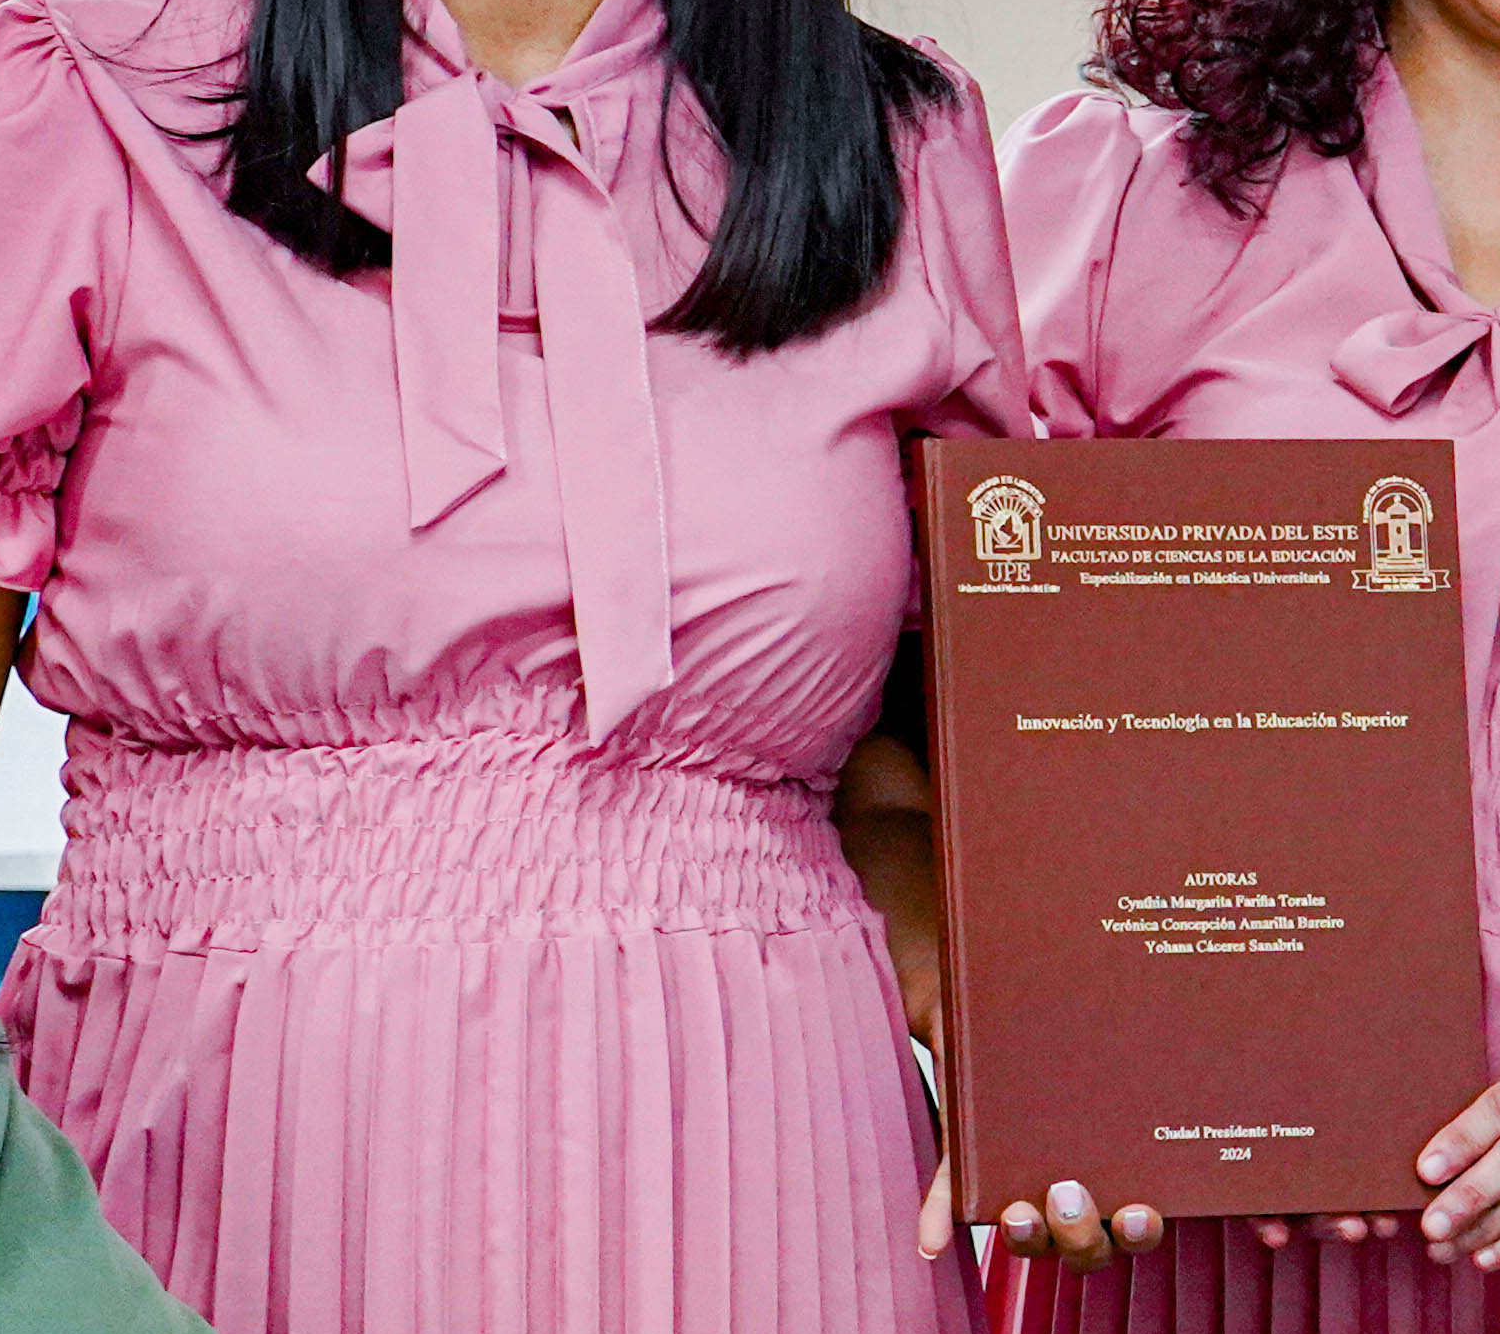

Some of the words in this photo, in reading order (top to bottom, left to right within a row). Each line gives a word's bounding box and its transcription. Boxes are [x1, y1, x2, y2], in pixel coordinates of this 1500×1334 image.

[1046, 524, 1178, 541] UNIVERSIDAD
[1182, 524, 1267, 541] PRIVADA
[1270, 524, 1310, 541] DEL
[1312, 524, 1359, 541] ESTE
[1050, 550, 1130, 564] FACULTAD
[1131, 550, 1153, 564] DE
[1154, 550, 1223, 564] CIENCIAS
[1225, 550, 1246, 564] DE
[1248, 550, 1269, 564] LA
[1270, 547, 1357, 563] EDUCACIÓN
[986, 561, 1032, 583] UPE
[1079, 571, 1174, 588] Especialización
[1175, 574, 1191, 585] en
[1192, 571, 1251, 585] Didáctica
[1252, 570, 1331, 585] Universitaria
[1016, 713, 1104, 731] Innovación
[1106, 717, 1119, 734] y
[1212, 716, 1233, 729] en
[1235, 712, 1253, 729] la
[1254, 711, 1338, 729] Educación
[1341, 710, 1409, 732] Superior
[1184, 871, 1258, 887] AUTORAS
[1117, 895, 1169, 913] Cynthia
[1170, 894, 1233, 912] Margarita
[1277, 893, 1326, 908] Torales
[1100, 917, 1160, 933] Verónica
[1161, 916, 1237, 934] Concepción
[1238, 915, 1295, 930] Amarilla
[1144, 940, 1195, 954] Yohana
[1195, 939, 1246, 954] Cáceres
[1248, 938, 1305, 953] Sanabria
[1153, 1125, 1201, 1141] Ciudad
[1202, 1124, 1269, 1139] Presidente
[1270, 1124, 1315, 1138] Franco
[1219, 1146, 1252, 1161] 2024
